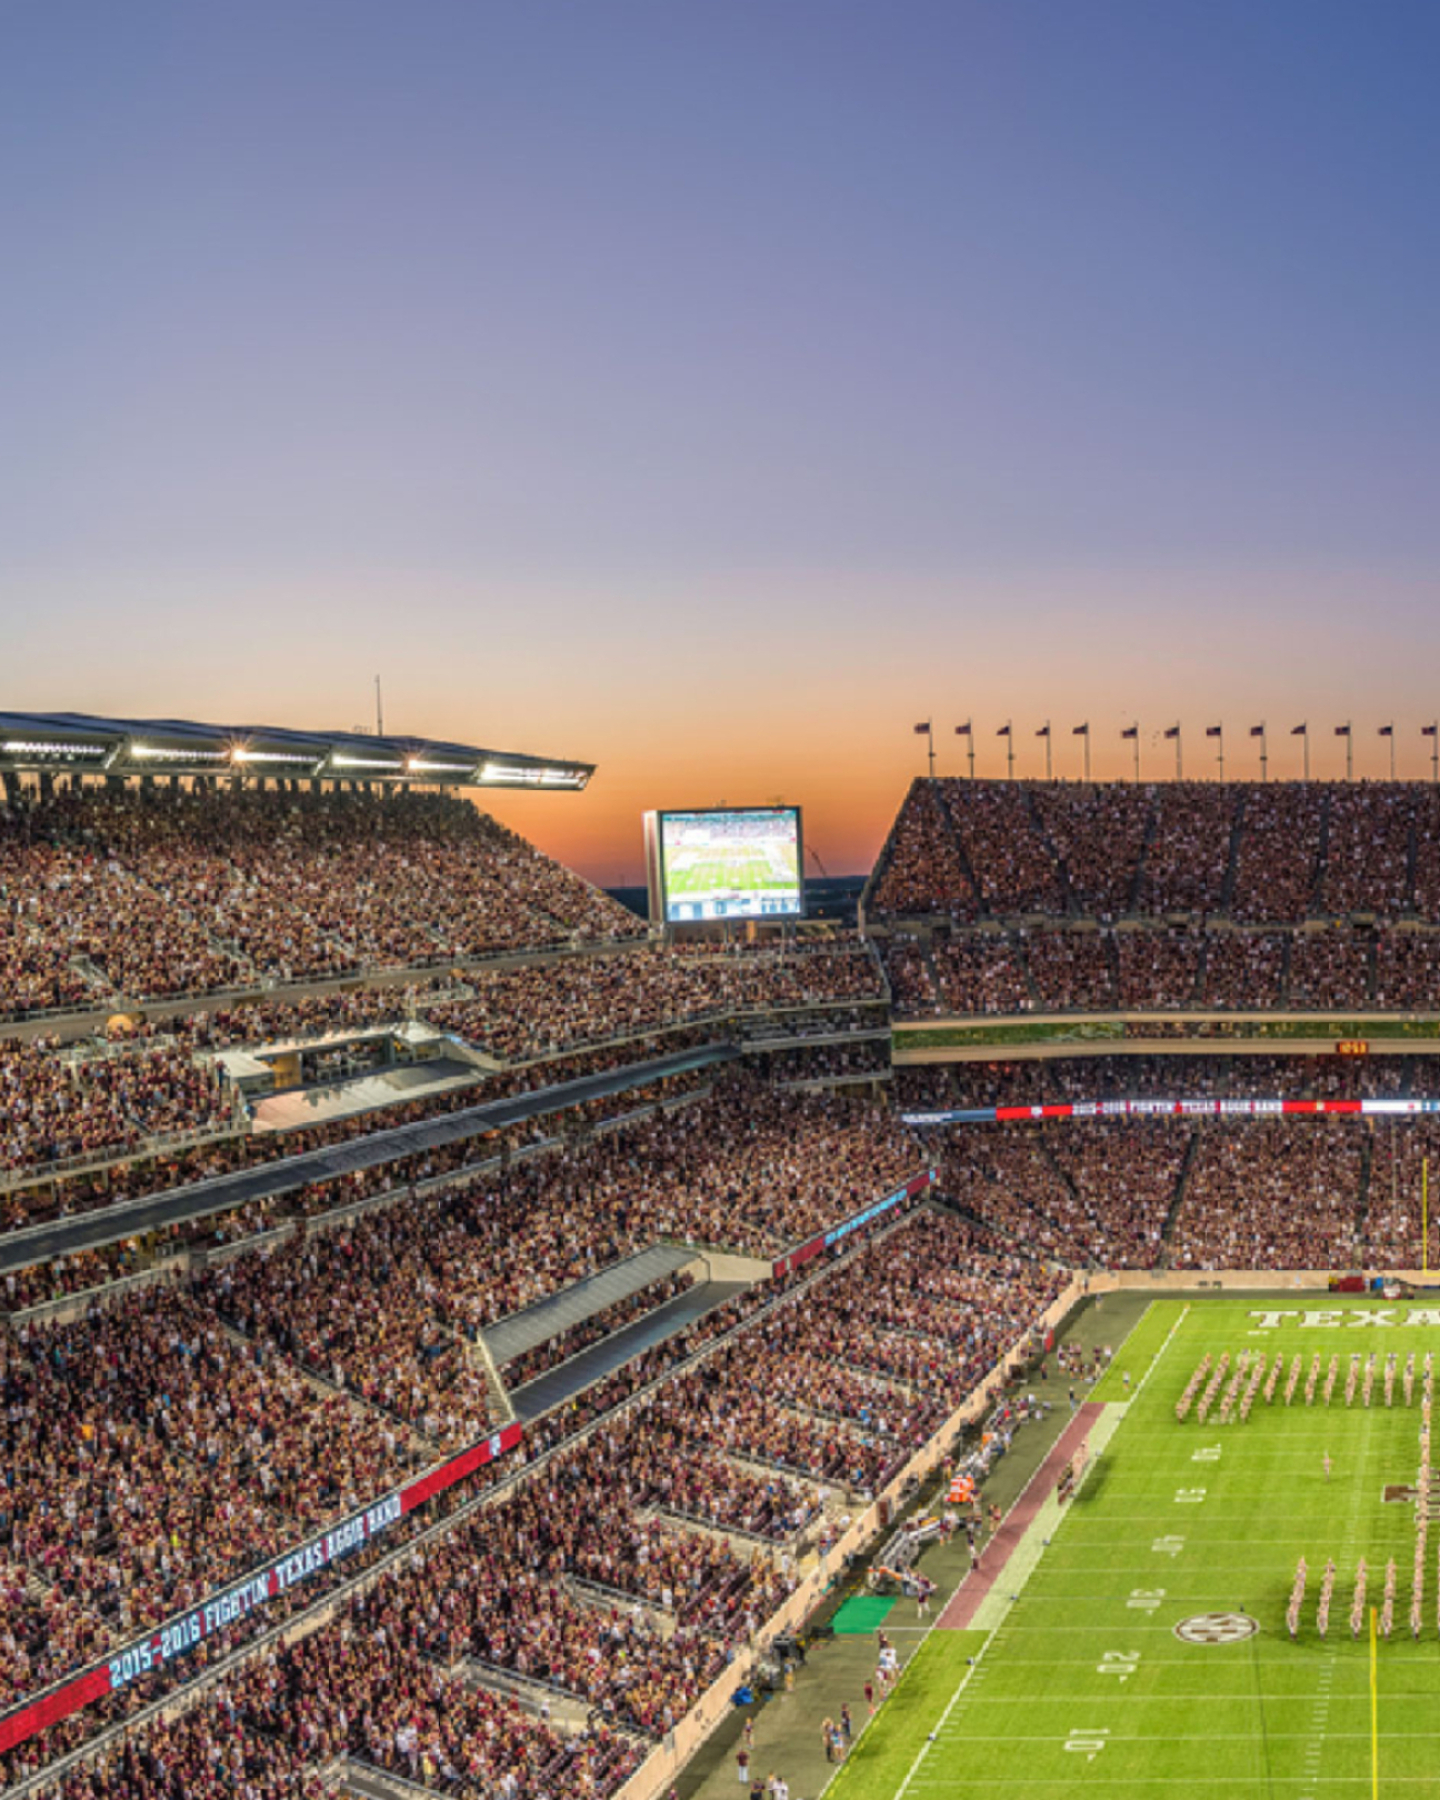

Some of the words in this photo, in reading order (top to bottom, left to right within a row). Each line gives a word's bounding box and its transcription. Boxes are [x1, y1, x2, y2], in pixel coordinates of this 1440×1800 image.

[109, 1612, 200, 1690] 2015-2016
[204, 1573, 269, 1634] FIGHTIN'
[275, 1543, 323, 1589] TEXAS
[327, 1517, 365, 1557] AGGIE
[367, 1495, 401, 1534] BAND
[1096, 1651, 1140, 1674] 20
[1063, 1728, 1110, 1751] 10
